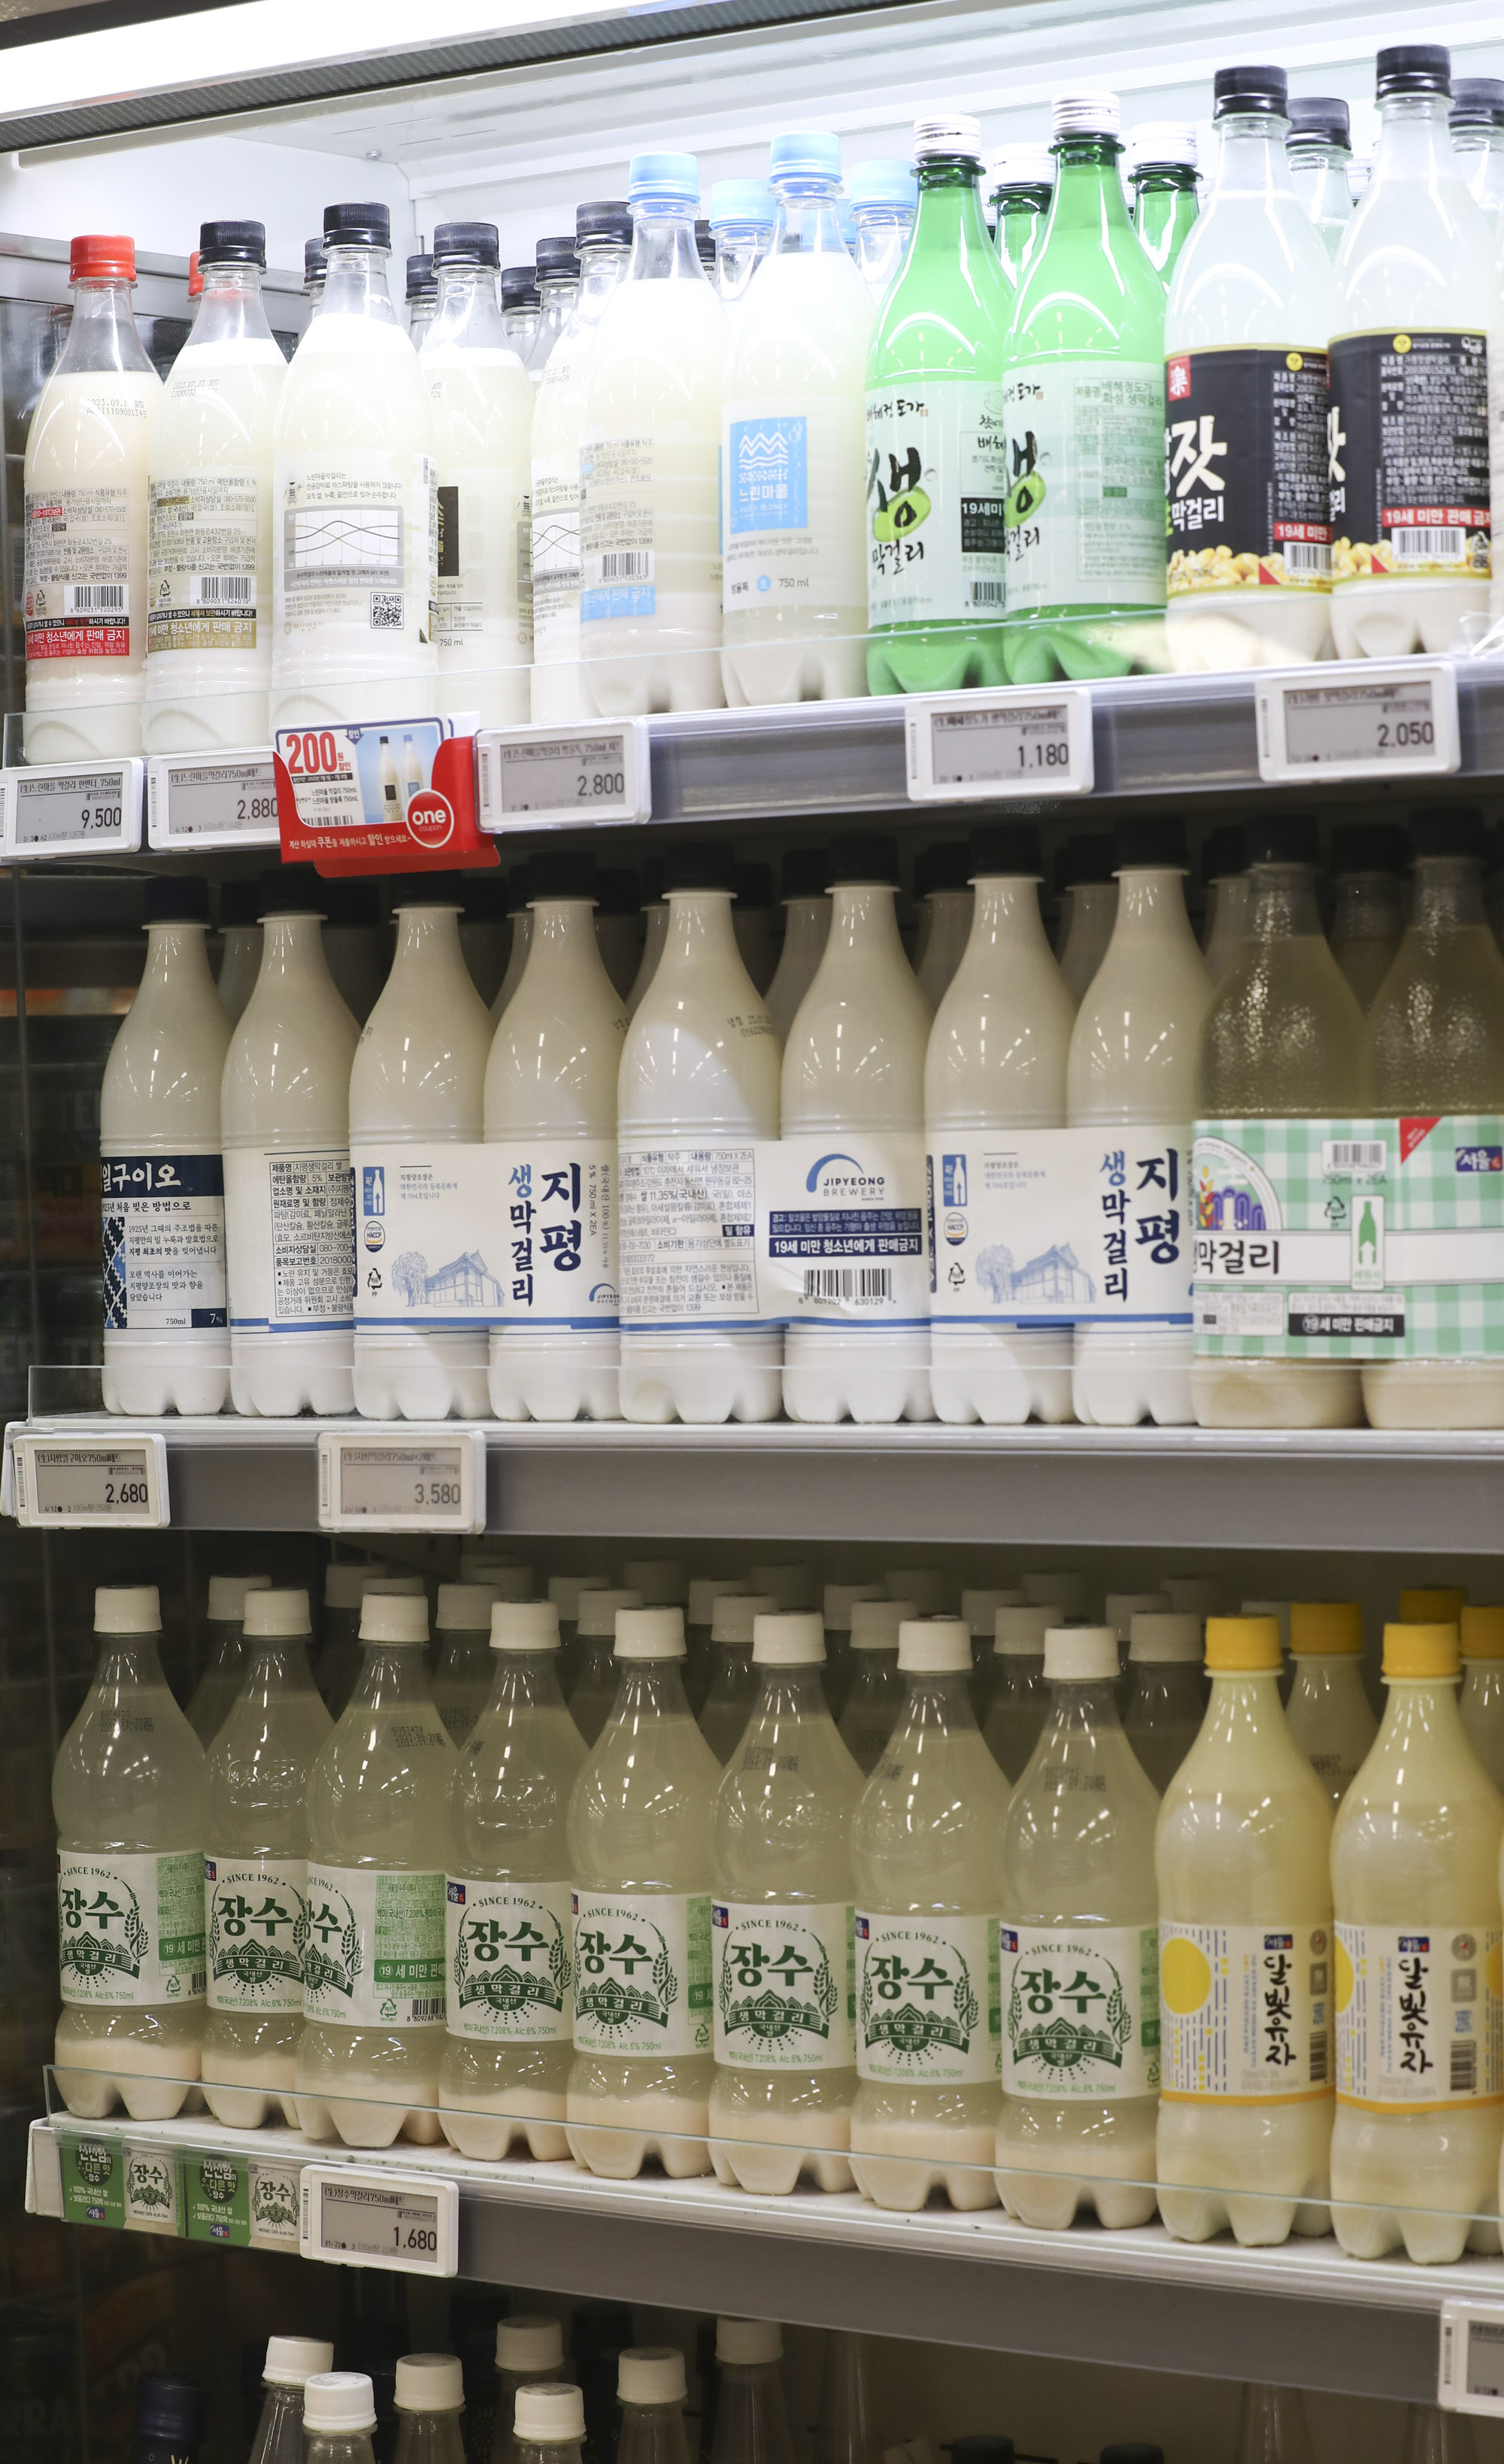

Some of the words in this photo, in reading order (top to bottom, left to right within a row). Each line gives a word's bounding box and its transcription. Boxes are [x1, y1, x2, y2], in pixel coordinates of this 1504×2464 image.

[1171, 415, 1228, 498] 잣
[739, 484, 788, 502] 느린마을
[1171, 496, 1224, 532] 막걸리
[1386, 510, 1415, 525] 19세
[1419, 509, 1443, 524] 미만
[1278, 524, 1304, 539] 19세
[872, 539, 924, 575] 막걸리
[779, 579, 795, 588] 750
[797, 577, 809, 587] ml
[170, 623, 210, 634] 청소년에게
[213, 622, 230, 633] 판매
[234, 622, 252, 632] 금지
[46, 631, 83, 643] 청소년에게
[86, 630, 104, 641] 판매
[107, 630, 125, 641] 금지
[347, 729, 359, 739] 할인
[286, 732, 338, 774] 200
[338, 762, 351, 771] 할인
[238, 798, 277, 820] 2,880
[82, 807, 121, 829] 9,500
[412, 809, 447, 826] one
[367, 834, 384, 846] 할인
[271, 1164, 292, 1172] 제품명
[295, 1162, 334, 1171] 지평생막걸리
[335, 1161, 342, 1171] 쌀
[1460, 1149, 1490, 1171] 서울
[102, 1162, 181, 1193] 일구이오
[272, 1174, 306, 1184] 에탄올함량
[823, 1177, 885, 1186] JIPYEONG
[273, 1187, 293, 1196] 업소명
[296, 1187, 302, 1196] 및
[305, 1186, 326, 1195] 소재지
[823, 1187, 884, 1196] BREWERY
[117, 1202, 130, 1212] 처음
[132, 1202, 149, 1211] 빚은
[153, 1202, 191, 1211] 방법으로
[273, 1199, 300, 1209] 원재료명
[302, 1199, 310, 1207] 및
[313, 1198, 326, 1207] 함량
[1135, 1148, 1179, 1265] 지평
[539, 1162, 581, 1272] 지평
[129, 1225, 148, 1233] 1925년
[174, 1224, 202, 1232] 주조법을
[205, 1224, 218, 1232] 따른
[725, 1226, 732, 1235] 밀
[735, 1225, 751, 1235] 함유
[1100, 1150, 1131, 1302] 생막걸리
[185, 1235, 219, 1244] 발효법으로
[508, 1163, 537, 1308] 생막걸리
[143, 1247, 162, 1256] 최초의
[165, 1247, 179, 1256] 맛을
[182, 1247, 217, 1256] 빚어냅니다
[276, 1244, 317, 1254] 소비자상담실
[775, 1241, 798, 1254] 19세
[801, 1240, 820, 1253] 미만
[823, 1239, 875, 1253] 청소년에게
[878, 1238, 918, 1252] 판매금지
[276, 1256, 317, 1266] 품목보고번호
[129, 1271, 142, 1279] 오랜
[144, 1270, 165, 1278] 역사를
[168, 1270, 198, 1278] 이어가는
[129, 1282, 169, 1290] 지평양조장의
[190, 1280, 203, 1290] 향을
[299, 1278, 310, 1287] 고유
[313, 1277, 338, 1286] 성분으로
[129, 1293, 162, 1302] 담았습니다
[854, 1297, 884, 1305] 630129
[209, 1314, 223, 1324] 7%
[1354, 1317, 1394, 1332] 판매금지
[105, 1484, 148, 1504] 2,680
[414, 1484, 461, 1505] 3,580
[67, 1867, 88, 1876] SINCE
[91, 1868, 111, 1879] 1962
[227, 1873, 254, 1884] SINCE
[257, 1874, 279, 1885] 1962
[319, 1878, 332, 1891] 1962
[61, 1887, 125, 1929] 장수
[478, 1896, 509, 1907] SINCE
[513, 1897, 536, 1909] 1962
[217, 1895, 294, 1936] 장수
[587, 1908, 613, 1918] SINCE
[616, 1908, 638, 1921] 1962
[741, 1919, 772, 1930] SINCE
[775, 1920, 799, 1932] 1962
[466, 1919, 550, 1962] 장수
[881, 1930, 911, 1942] SINCE
[914, 1932, 938, 1944] 1962
[177, 1944, 186, 1955] 세
[187, 1941, 200, 1953] 미만
[579, 1930, 653, 1975] 장수
[1032, 1944, 1063, 1955] SINCE
[1067, 1944, 1092, 1956] 1962
[67, 1949, 116, 1965] 생막걸리
[225, 1958, 284, 1971] 생막걸리
[381, 1966, 392, 1975] 19
[396, 1965, 405, 1978] 세
[409, 1963, 428, 1978] 미만
[730, 1942, 814, 1987] 장수
[243, 1970, 262, 1978] 국내산
[870, 1954, 954, 2001] 장수
[475, 1984, 539, 1997] 생막걸리
[1020, 1968, 1107, 2014] 장수
[238, 1999, 258, 2007] 7.208%
[261, 1999, 281, 2008] Alc.6%
[585, 1997, 643, 2012] 생막걸리
[330, 2008, 347, 2019] 750ml
[738, 2010, 805, 2023] 생막걸리
[490, 2026, 511, 2035] 7.208%
[514, 2026, 535, 2035] Alc.6%
[538, 2026, 556, 2035] 750ml
[619, 2041, 640, 2050] Alc.6%
[641, 2041, 662, 2050] 750ml
[803, 2053, 823, 2063] 750ml
[103, 2164, 111, 2175] 맛
[133, 2164, 164, 2184] 장수
[228, 2181, 235, 2193] 맛
[259, 2181, 290, 2202] 장수
[213, 2191, 224, 2199] 장수
[394, 2226, 437, 2251] 1,680
